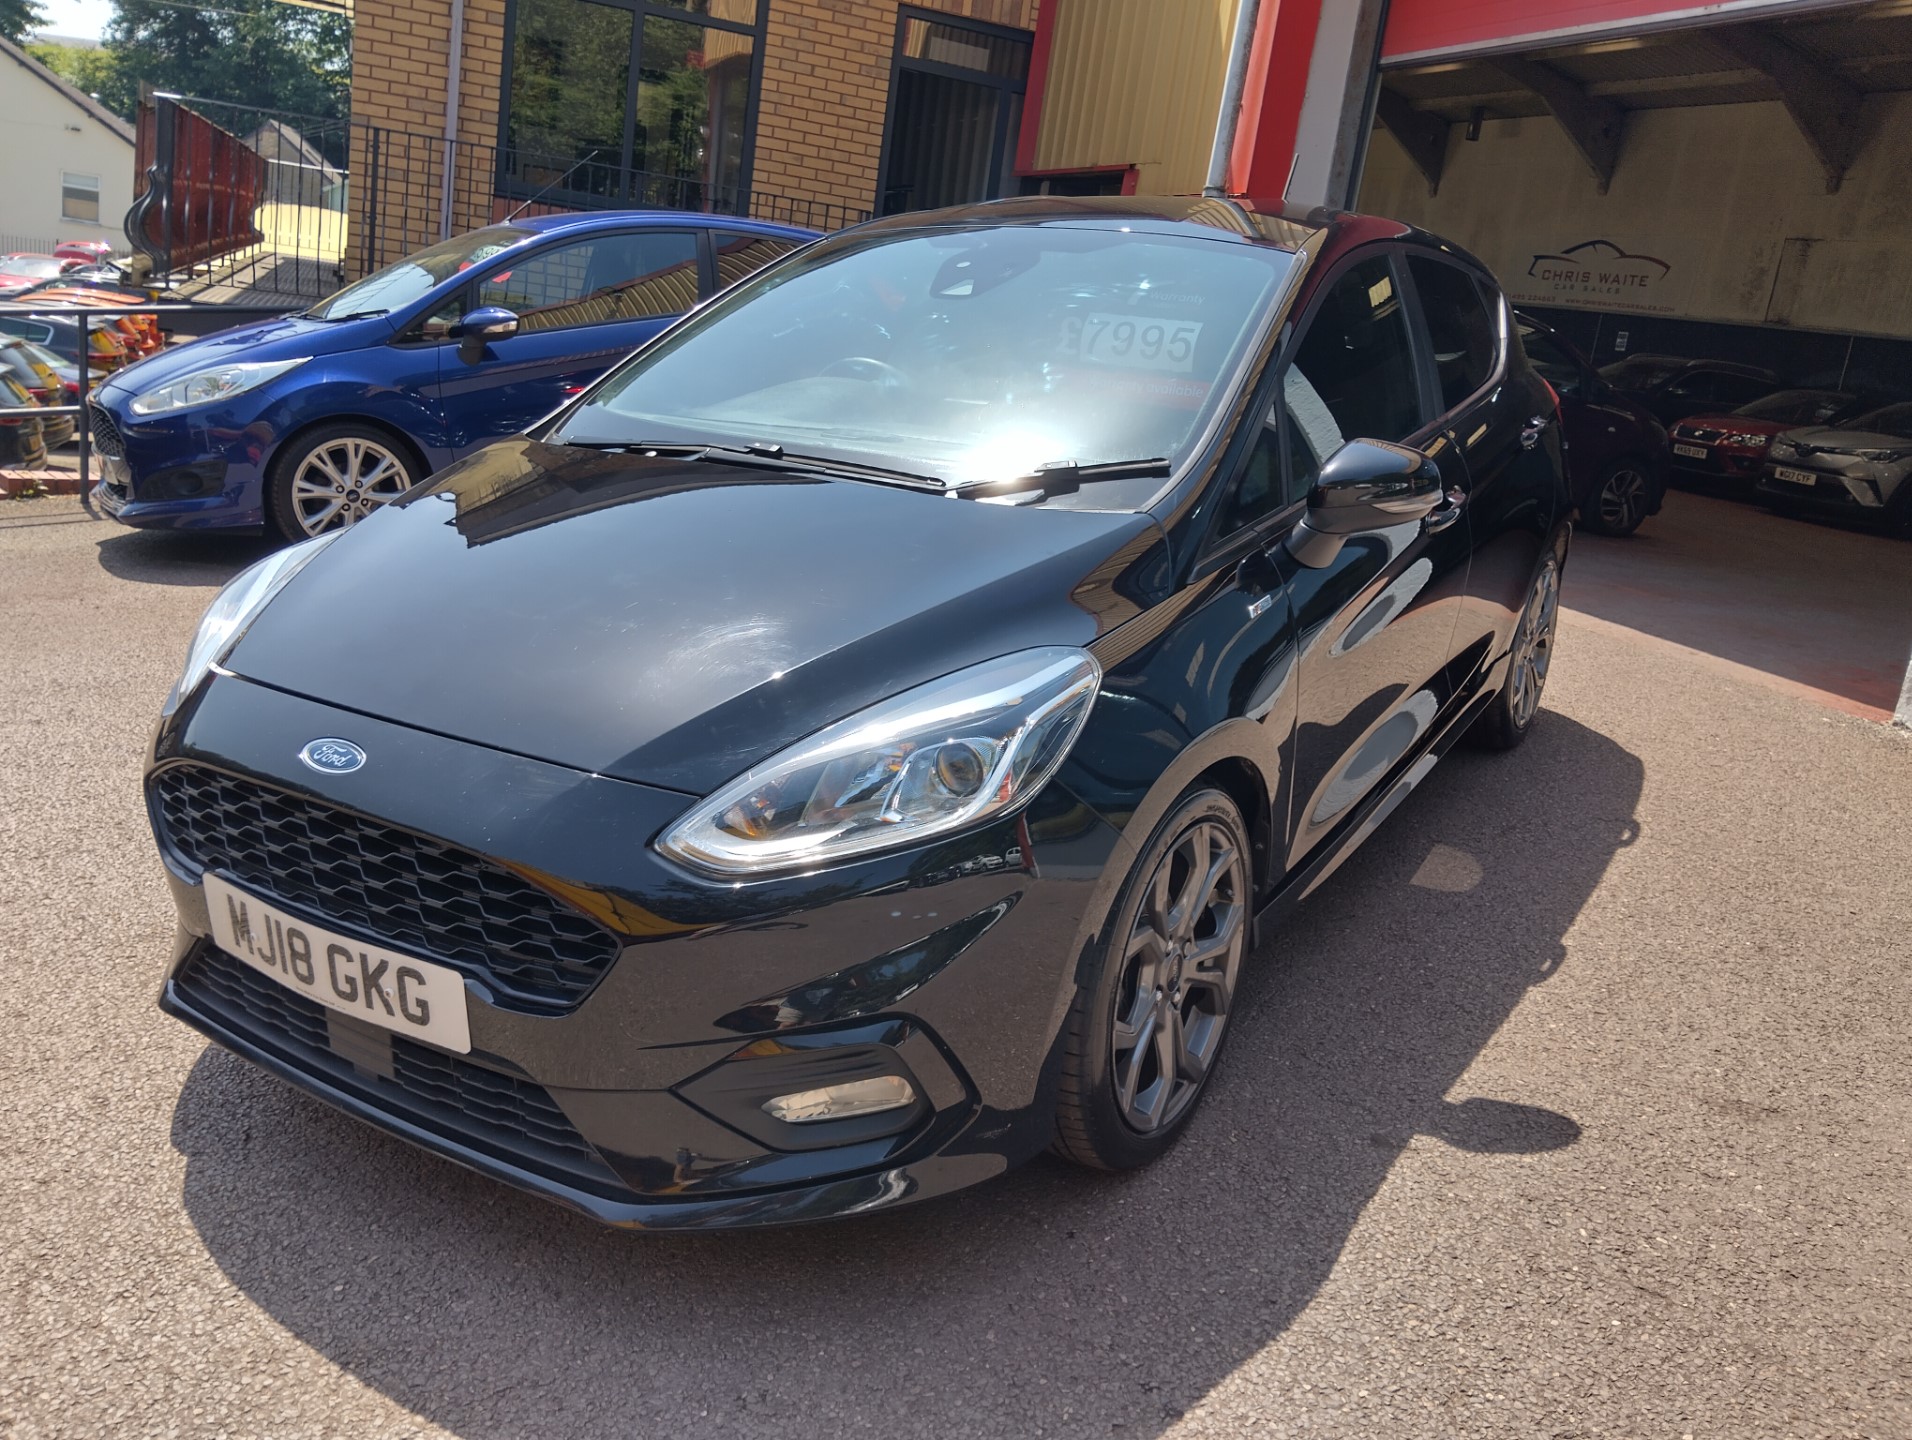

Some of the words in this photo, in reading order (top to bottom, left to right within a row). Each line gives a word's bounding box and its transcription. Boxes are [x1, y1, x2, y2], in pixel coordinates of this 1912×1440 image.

[1541, 269, 1591, 283] CHRIS
[1599, 273, 1649, 287] WAITE
[1150, 289, 1205, 305] Warranty
[1583, 285, 1621, 295] SALES
[1147, 381, 1204, 398] available
[313, 744, 353, 767] Ford
[226, 894, 315, 986] MJ18
[327, 943, 431, 1027] GKG
